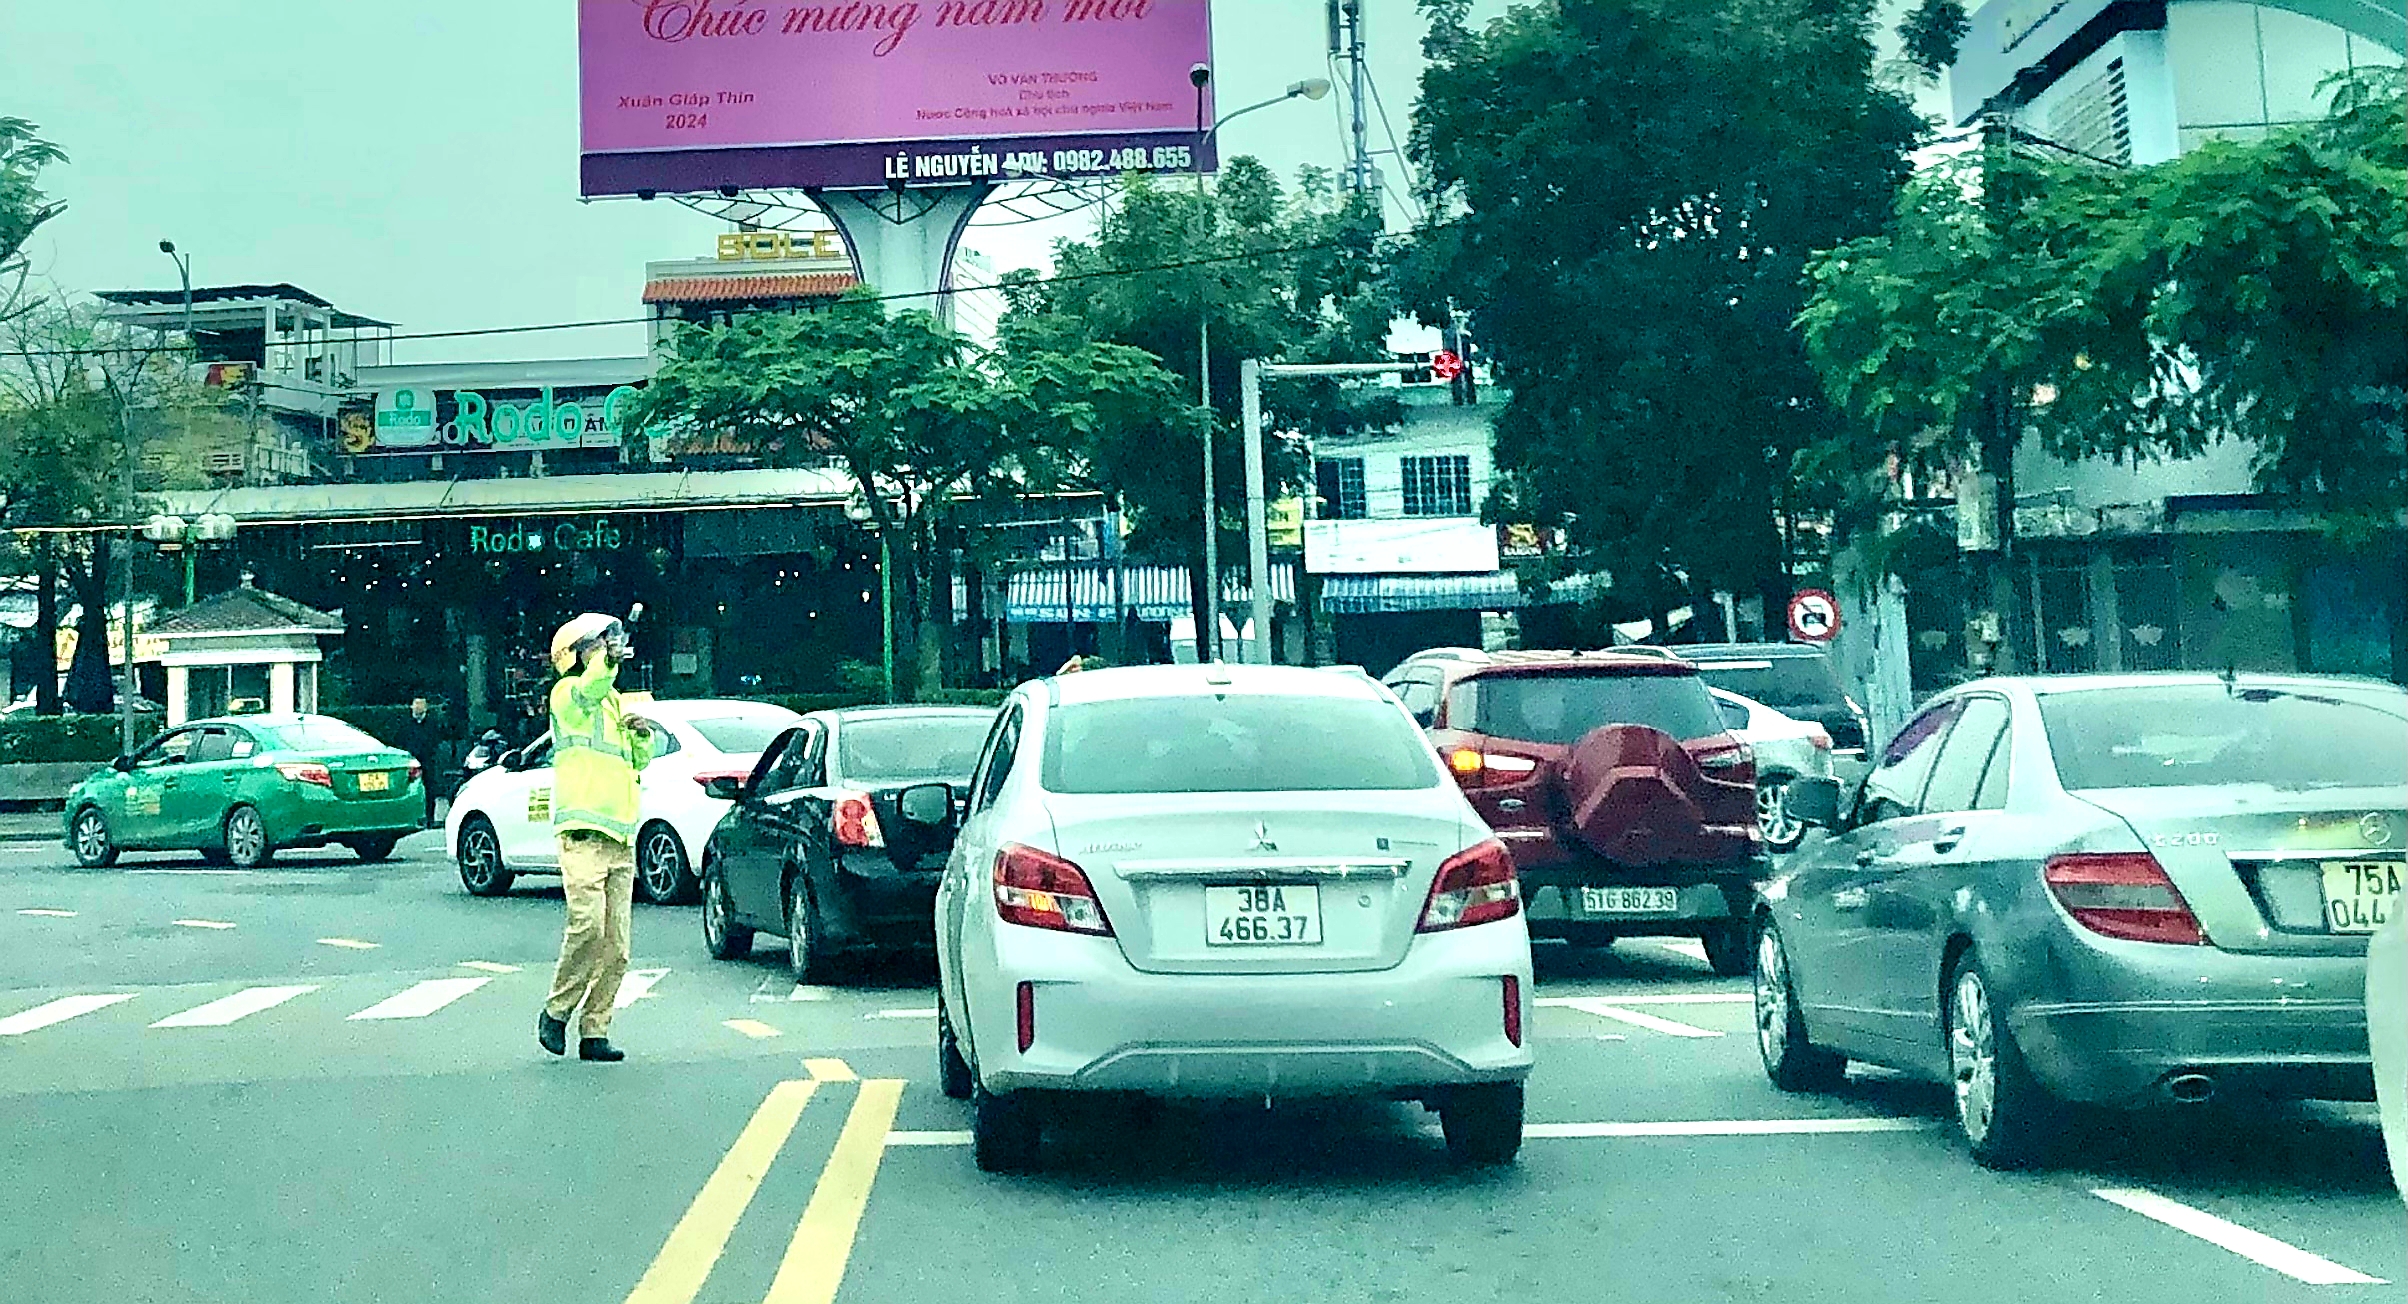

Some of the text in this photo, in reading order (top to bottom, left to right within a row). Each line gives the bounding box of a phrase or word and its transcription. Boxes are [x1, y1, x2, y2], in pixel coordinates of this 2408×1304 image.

[665, 113, 707, 129] 2024
[885, 151, 910, 179] LÊ
[915, 144, 998, 177] NGUYỄN
[1053, 145, 1191, 173] 0982.488.655
[453, 385, 584, 445] Rodo
[2345, 864, 2403, 896] 75A
[1238, 887, 1287, 913] 38A
[1219, 915, 1308, 941] 466.37
